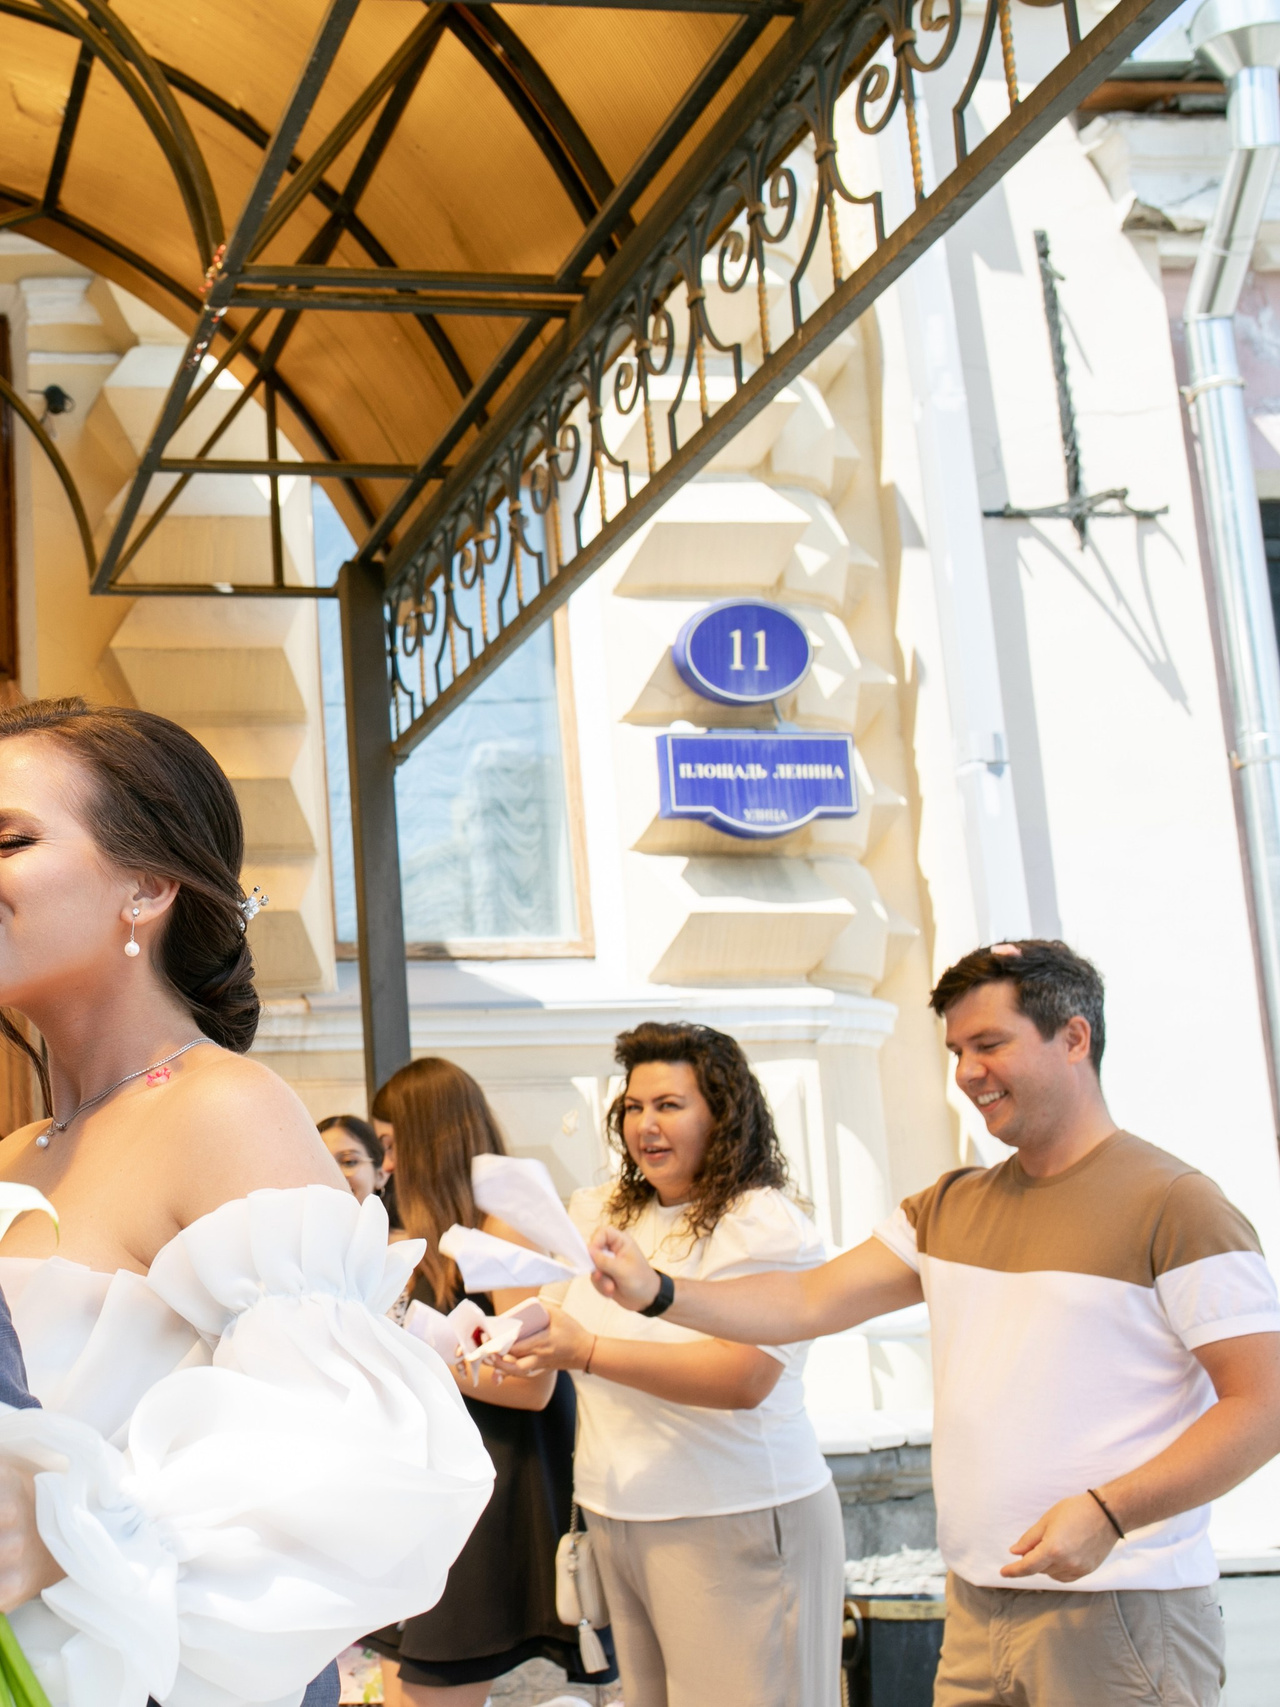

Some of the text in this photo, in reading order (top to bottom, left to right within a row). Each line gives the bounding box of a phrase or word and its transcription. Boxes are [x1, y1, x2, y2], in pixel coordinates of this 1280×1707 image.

[729, 629, 769, 671] 11
[678, 763, 845, 780] ПЛОЩАДЬ ЛЕНИНА
